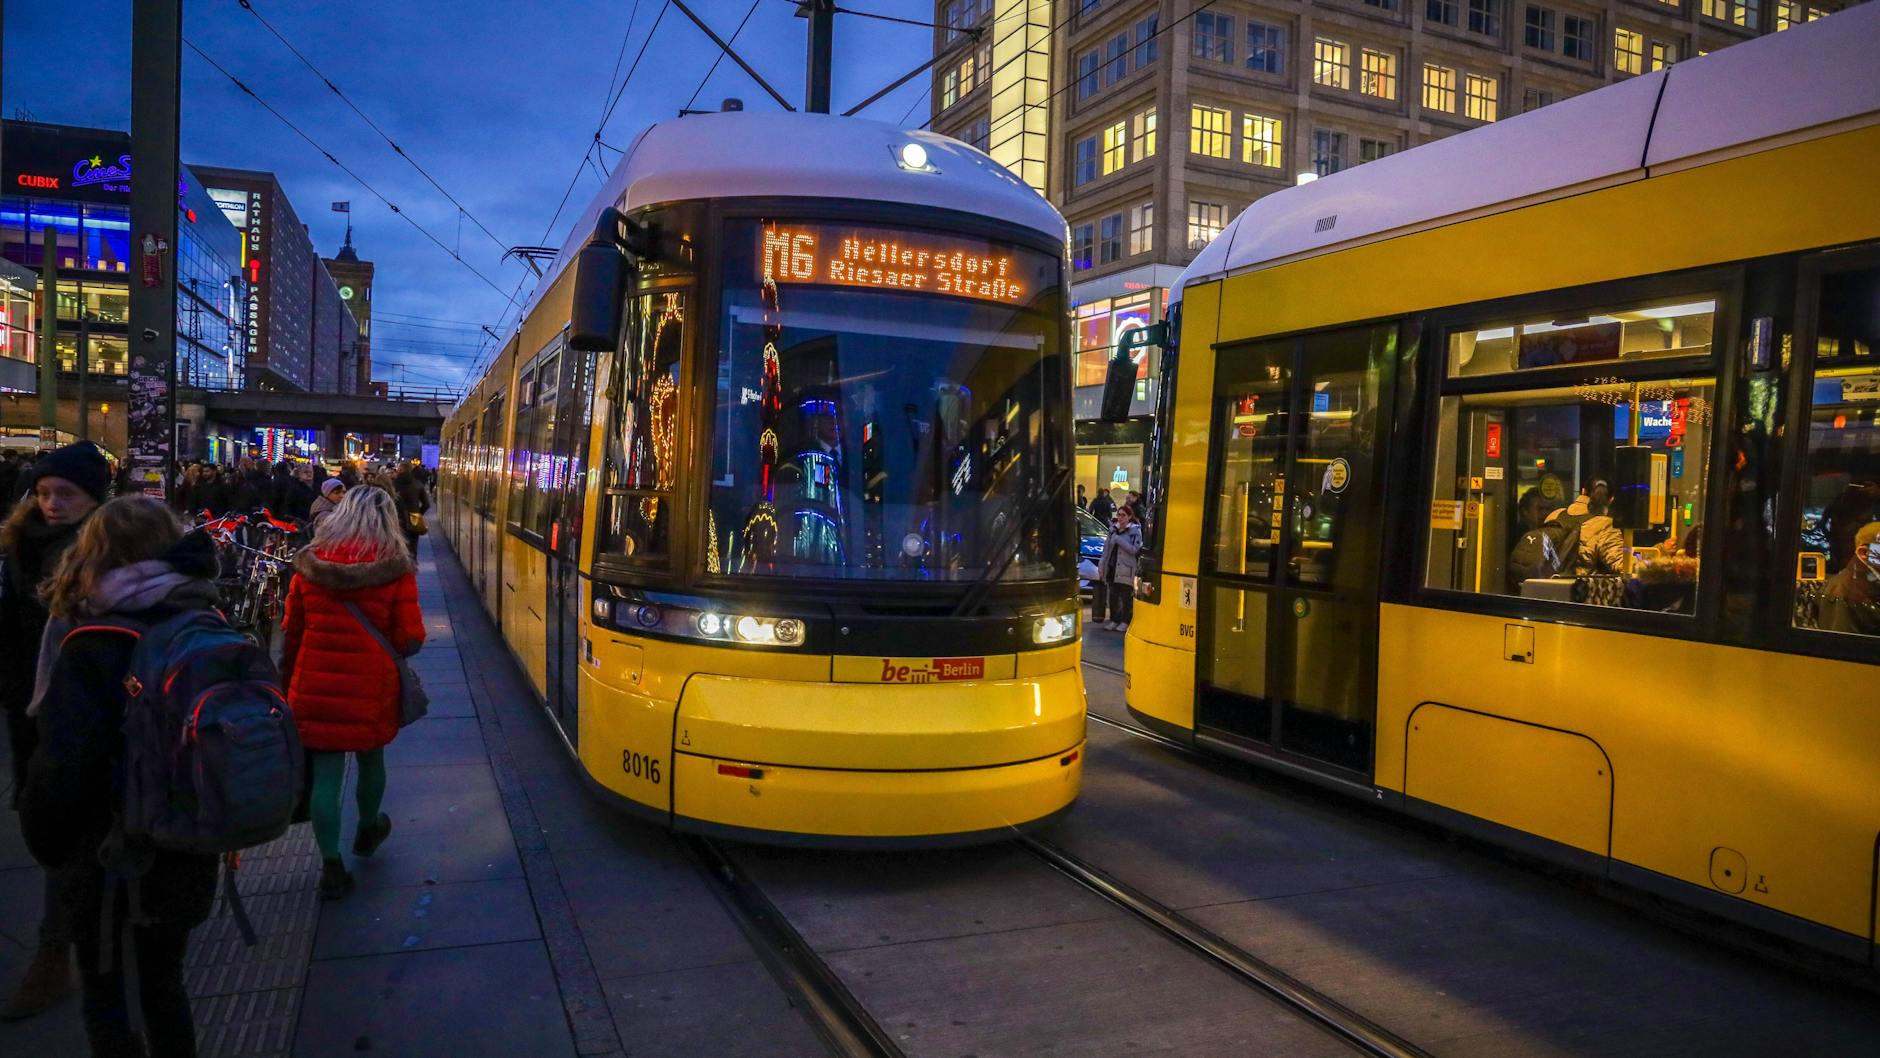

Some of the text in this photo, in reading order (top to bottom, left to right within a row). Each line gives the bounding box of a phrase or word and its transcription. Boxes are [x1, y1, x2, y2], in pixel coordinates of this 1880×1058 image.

[18, 174, 59, 189] CUBIX
[251, 192, 262, 251] RATHAUS
[764, 230, 1008, 279] M6 Hellersdorf
[830, 259, 1022, 299] Riesaer Straße
[248, 286, 259, 353] PASSAGEN
[1113, 465, 1128, 482] dm
[1180, 623, 1194, 638] BVG
[881, 659, 980, 682] be Berlin
[622, 749, 661, 784] 8016
